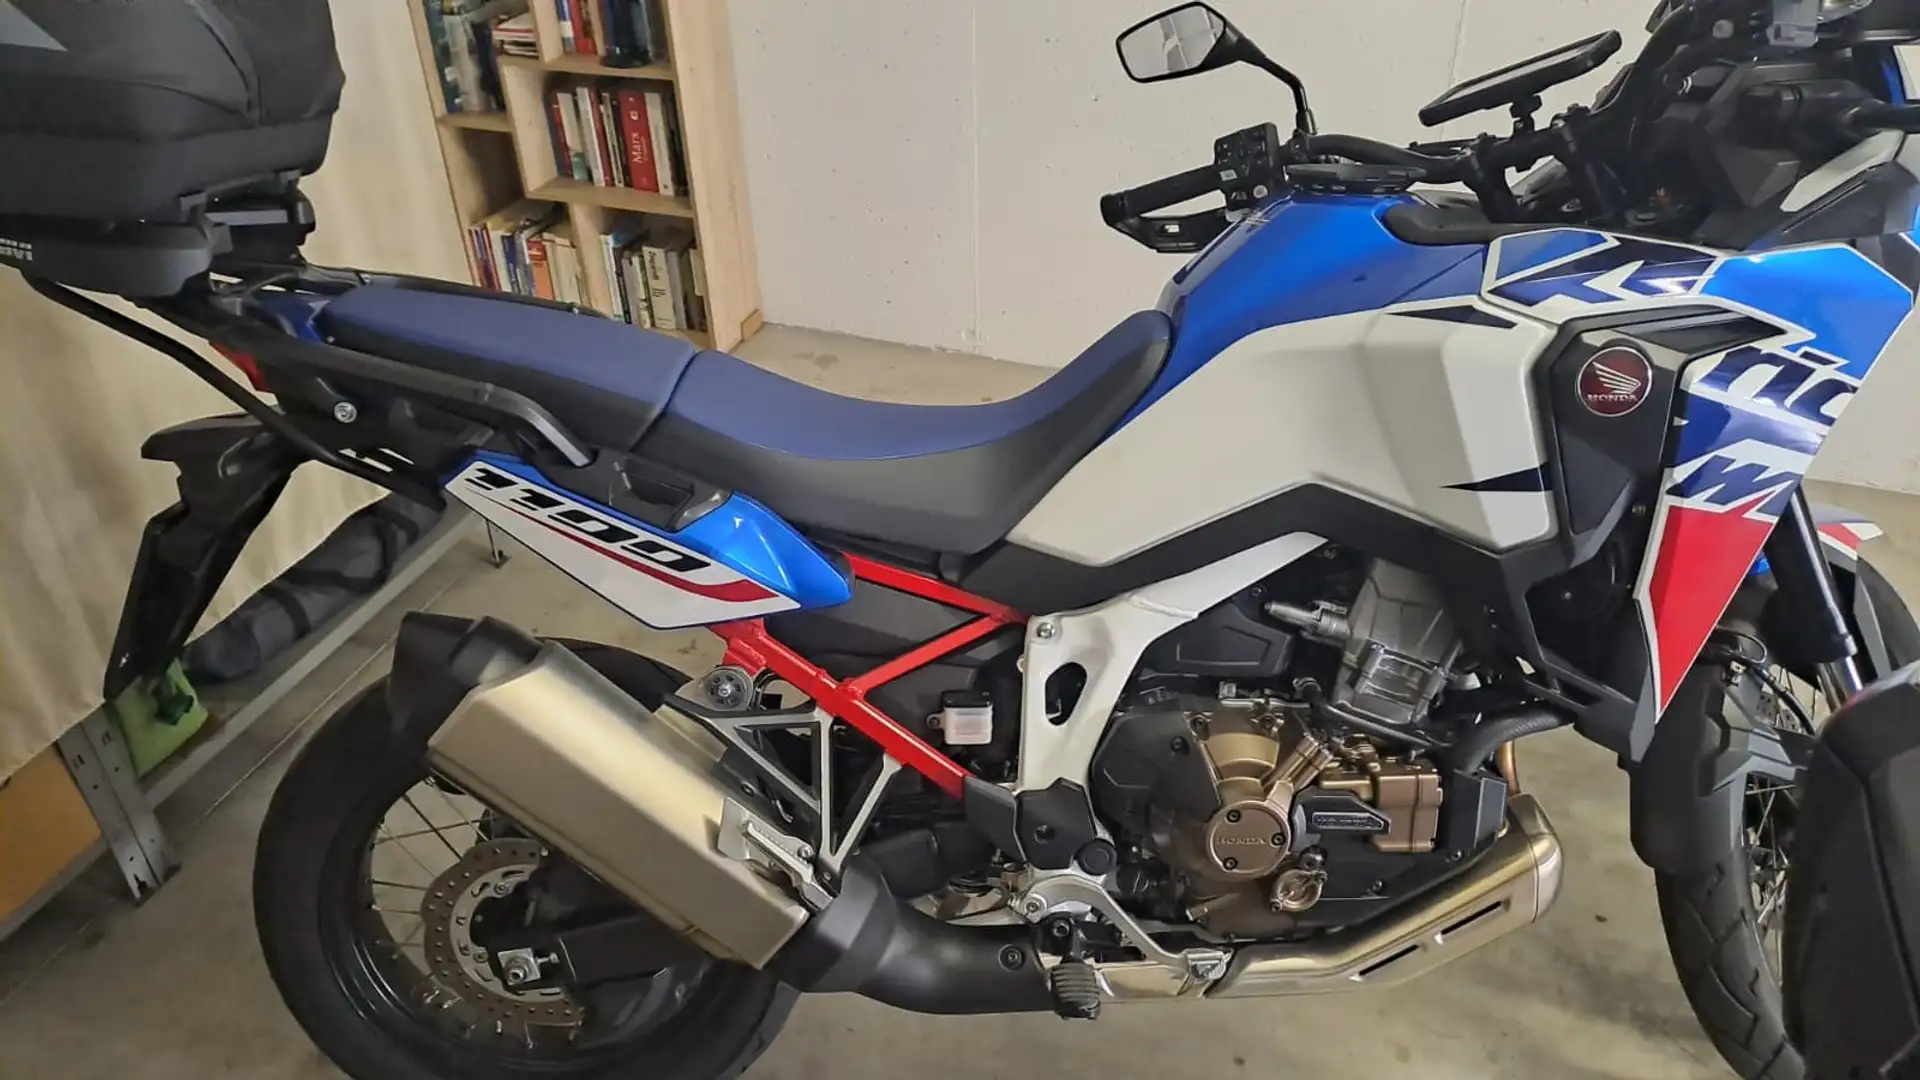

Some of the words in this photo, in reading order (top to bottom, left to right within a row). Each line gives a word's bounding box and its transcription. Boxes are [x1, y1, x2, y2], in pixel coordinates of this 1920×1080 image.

[1587, 394, 1638, 403] HONDA
[464, 467, 712, 572] 1100
[1216, 836, 1267, 846] HONDA
